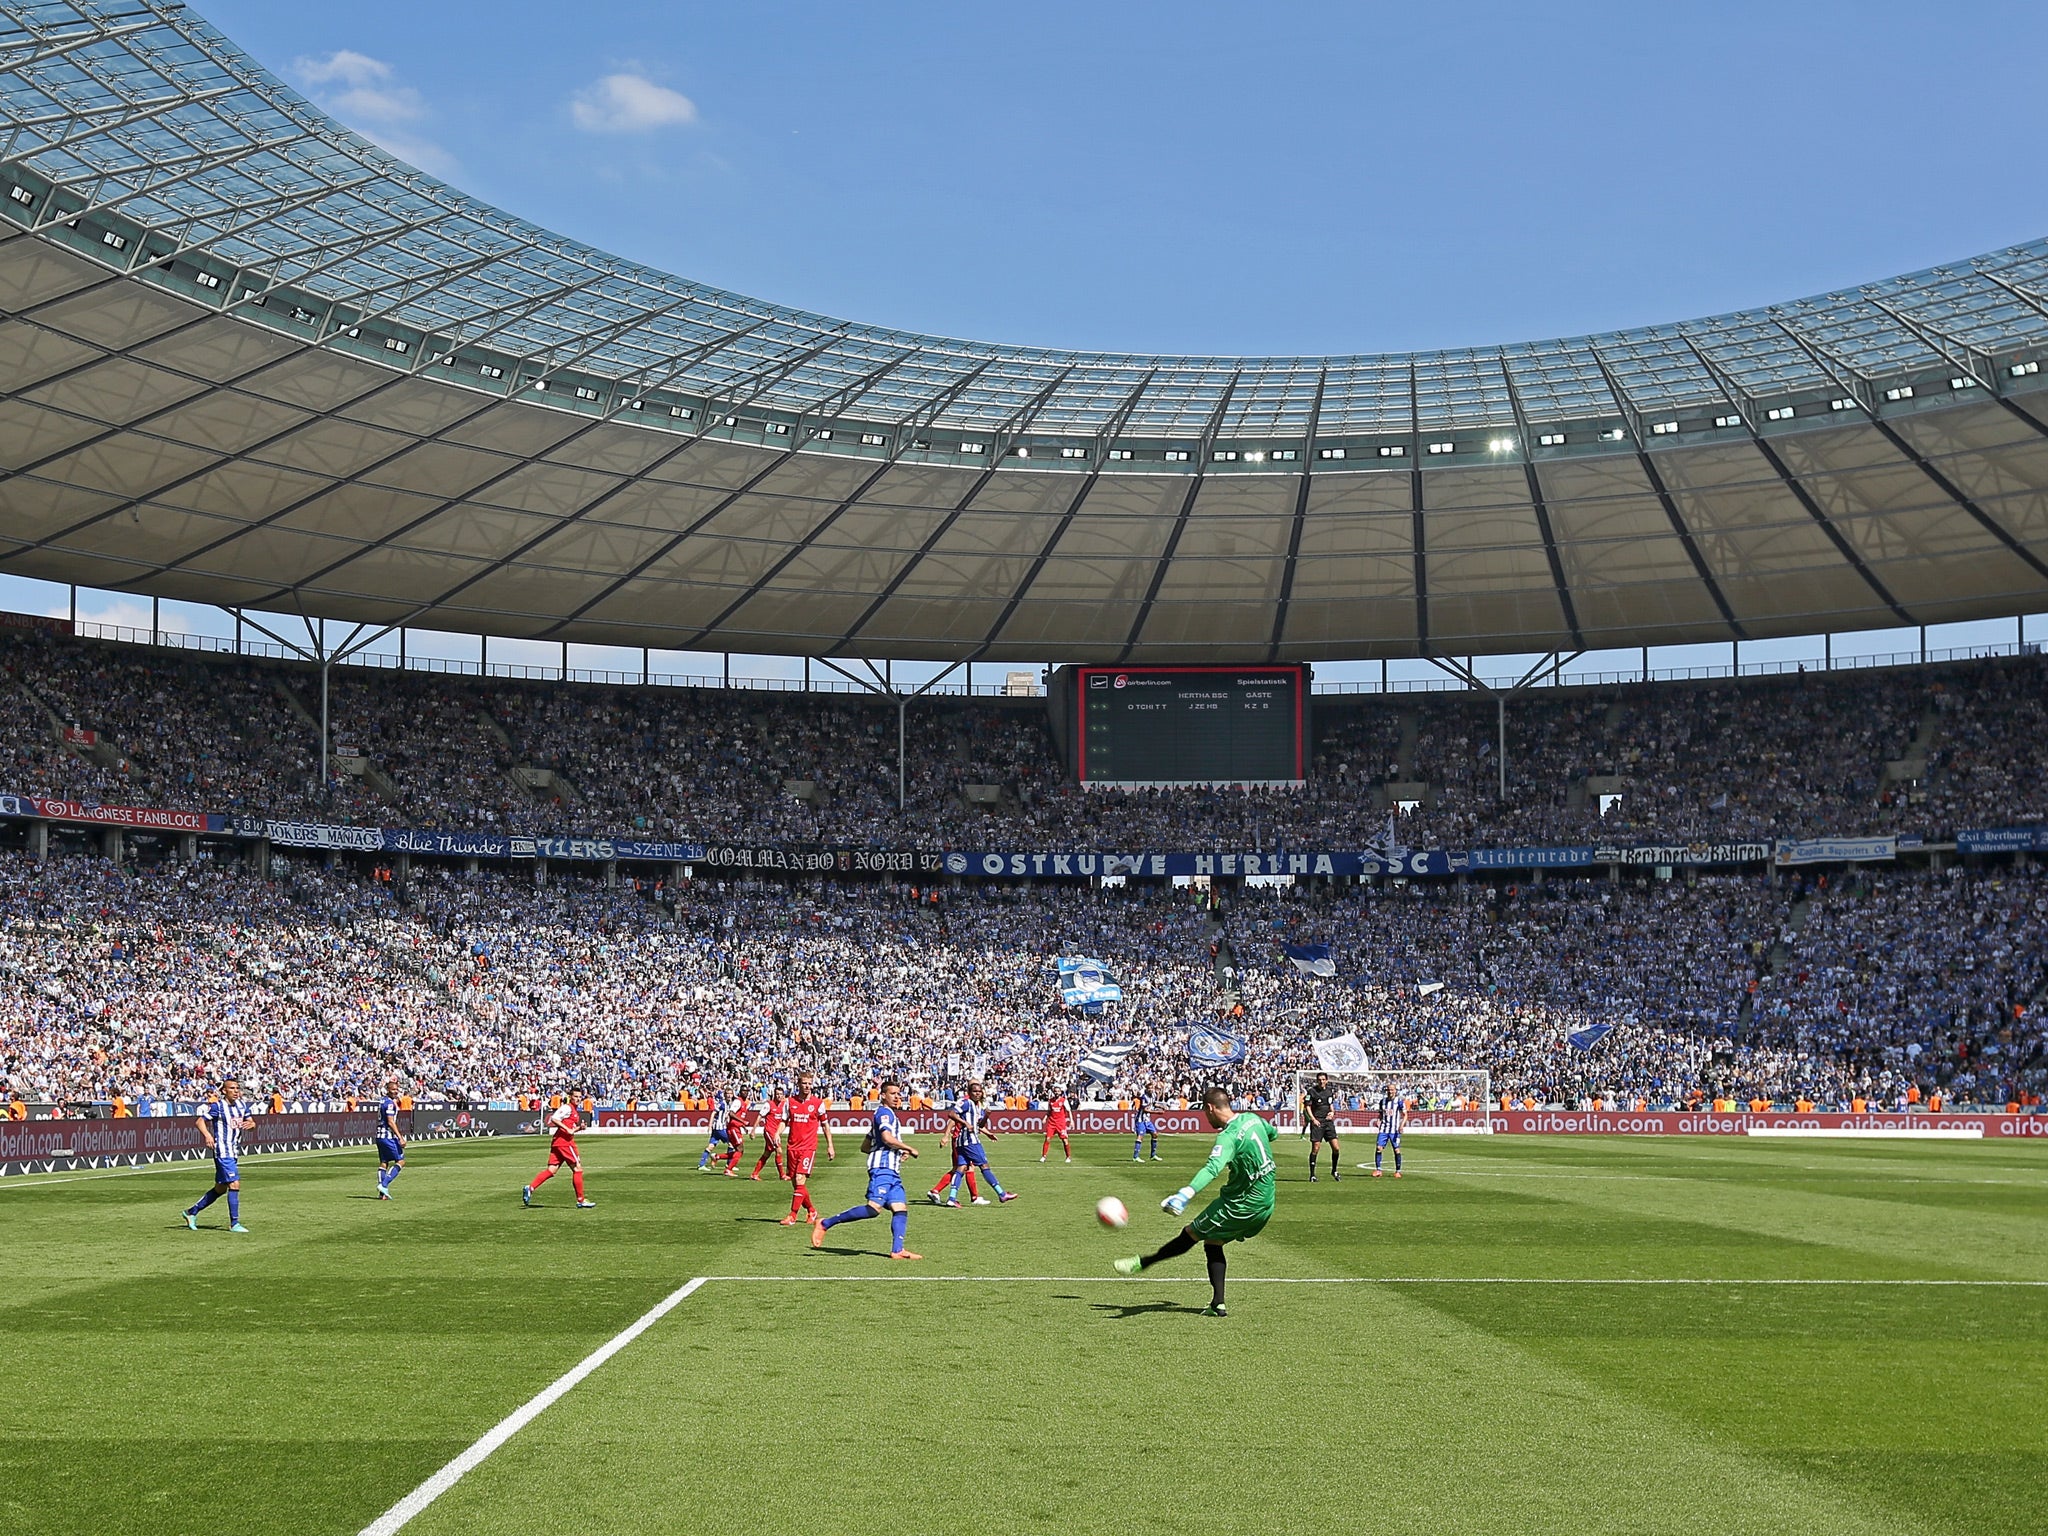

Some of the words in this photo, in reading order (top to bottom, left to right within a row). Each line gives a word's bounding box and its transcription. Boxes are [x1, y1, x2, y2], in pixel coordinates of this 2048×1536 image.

[1237, 678, 1287, 686] Spielstatistik
[70, 805, 133, 822] LANGNESE
[137, 810, 200, 828] FANBLOCK
[269, 825, 319, 841] JOKERS
[327, 830, 381, 846] MANIACS
[395, 833, 433, 849] Blue
[437, 836, 504, 855] Thunder
[536, 839, 615, 859] 71ERS
[633, 842, 682, 857] SZENE
[707, 847, 834, 870] COMMANDO
[855, 851, 913, 871] NORD
[1475, 851, 1588, 864] Lichtenrade
[257, 1117, 299, 1140] airberlin.com
[303, 1115, 340, 1137] airberlin.com
[1523, 1113, 1664, 1132] airberlin.com
[1678, 1114, 1821, 1132] airberlincom
[1841, 1115, 1985, 1133] airberlincom
[70, 1123, 136, 1153] airberlin.com
[144, 1119, 200, 1148] airberlin.com
[1251, 1131, 1272, 1168] 1
[803, 1157, 809, 1166] 6
